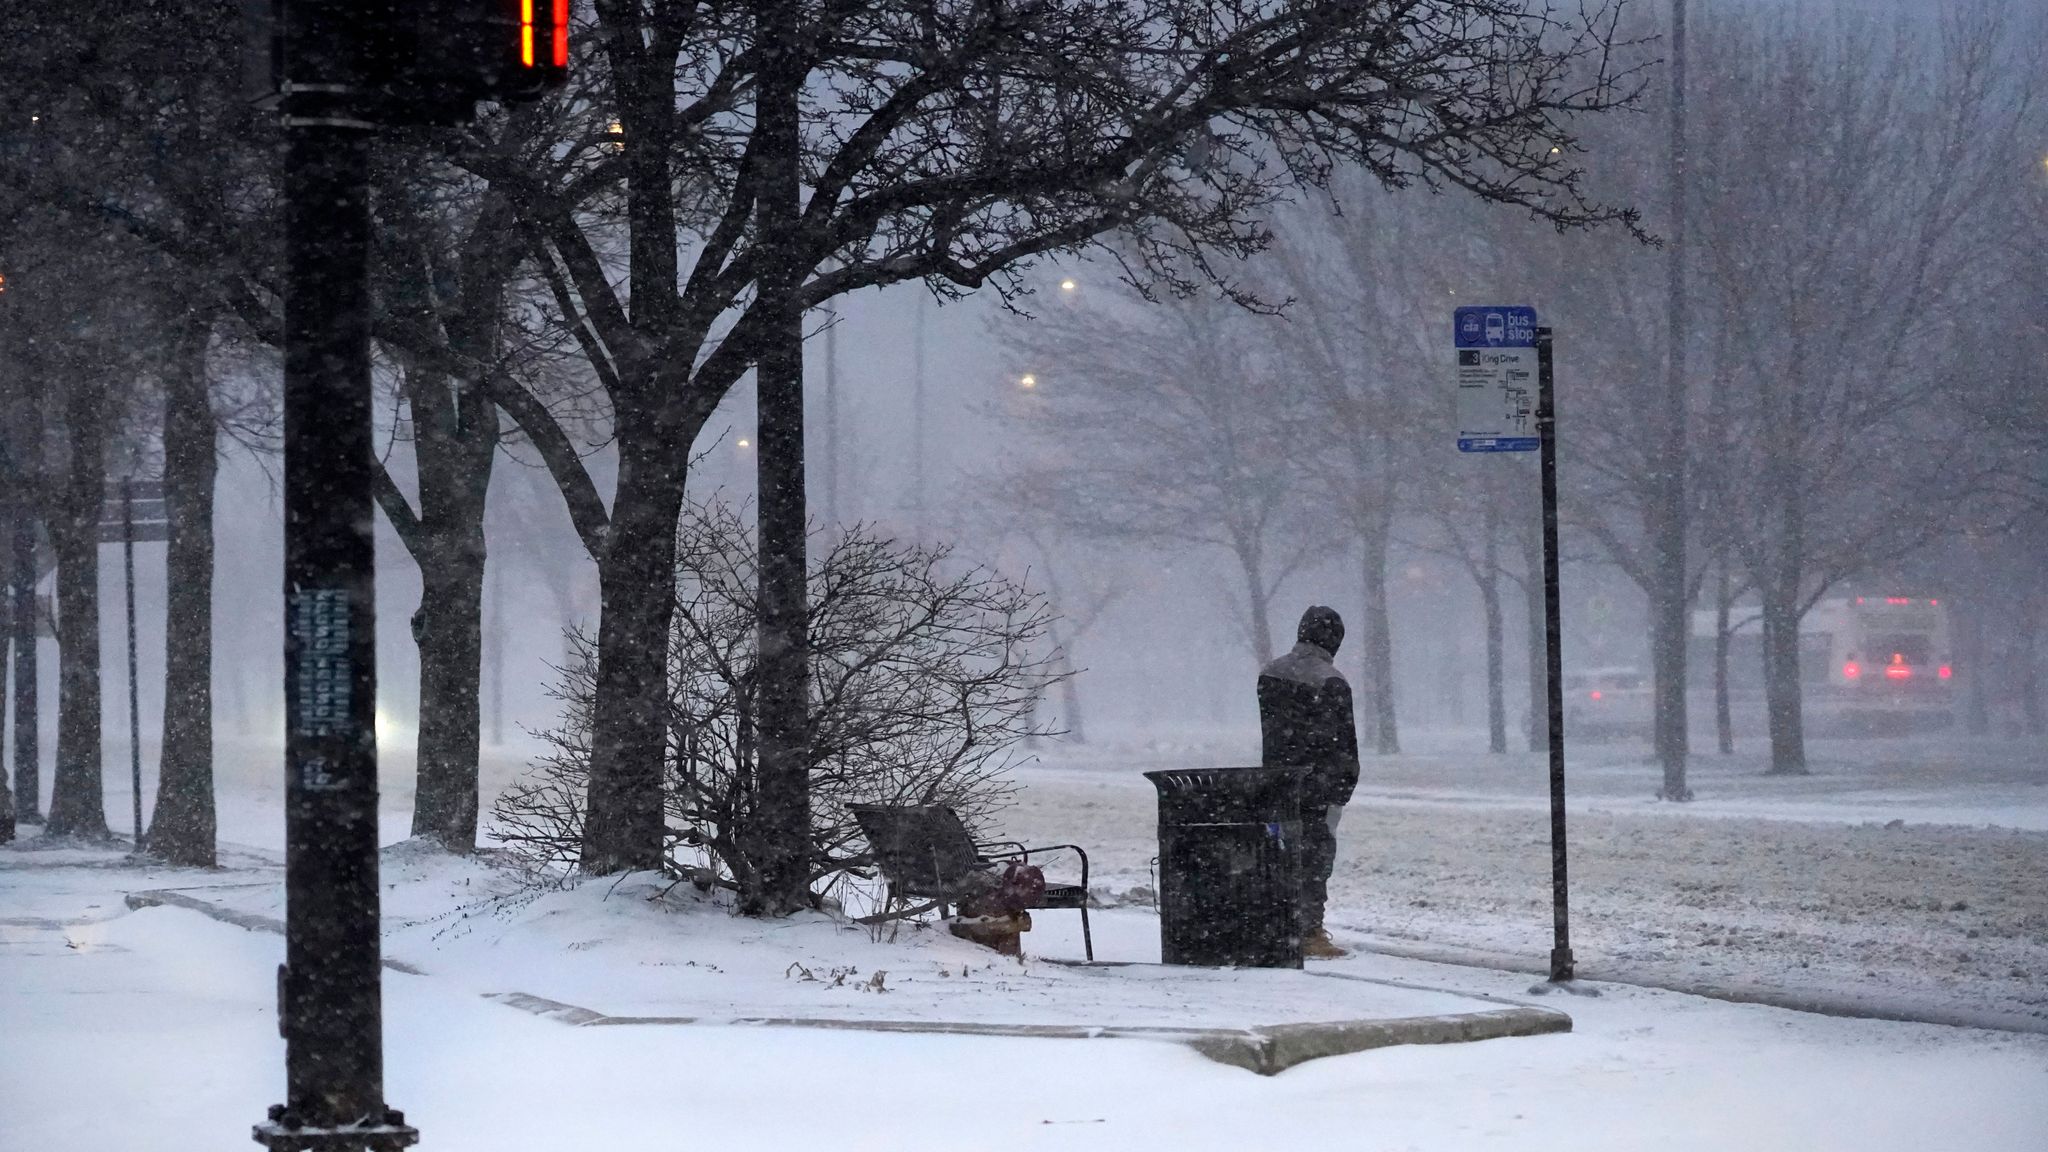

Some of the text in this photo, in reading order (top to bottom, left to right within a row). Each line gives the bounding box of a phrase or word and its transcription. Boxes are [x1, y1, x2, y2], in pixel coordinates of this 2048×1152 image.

[1508, 312, 1529, 326] bus
[1508, 327, 1534, 342] stop
[1472, 353, 1479, 363] 3
[1500, 354, 1520, 363] Drive
